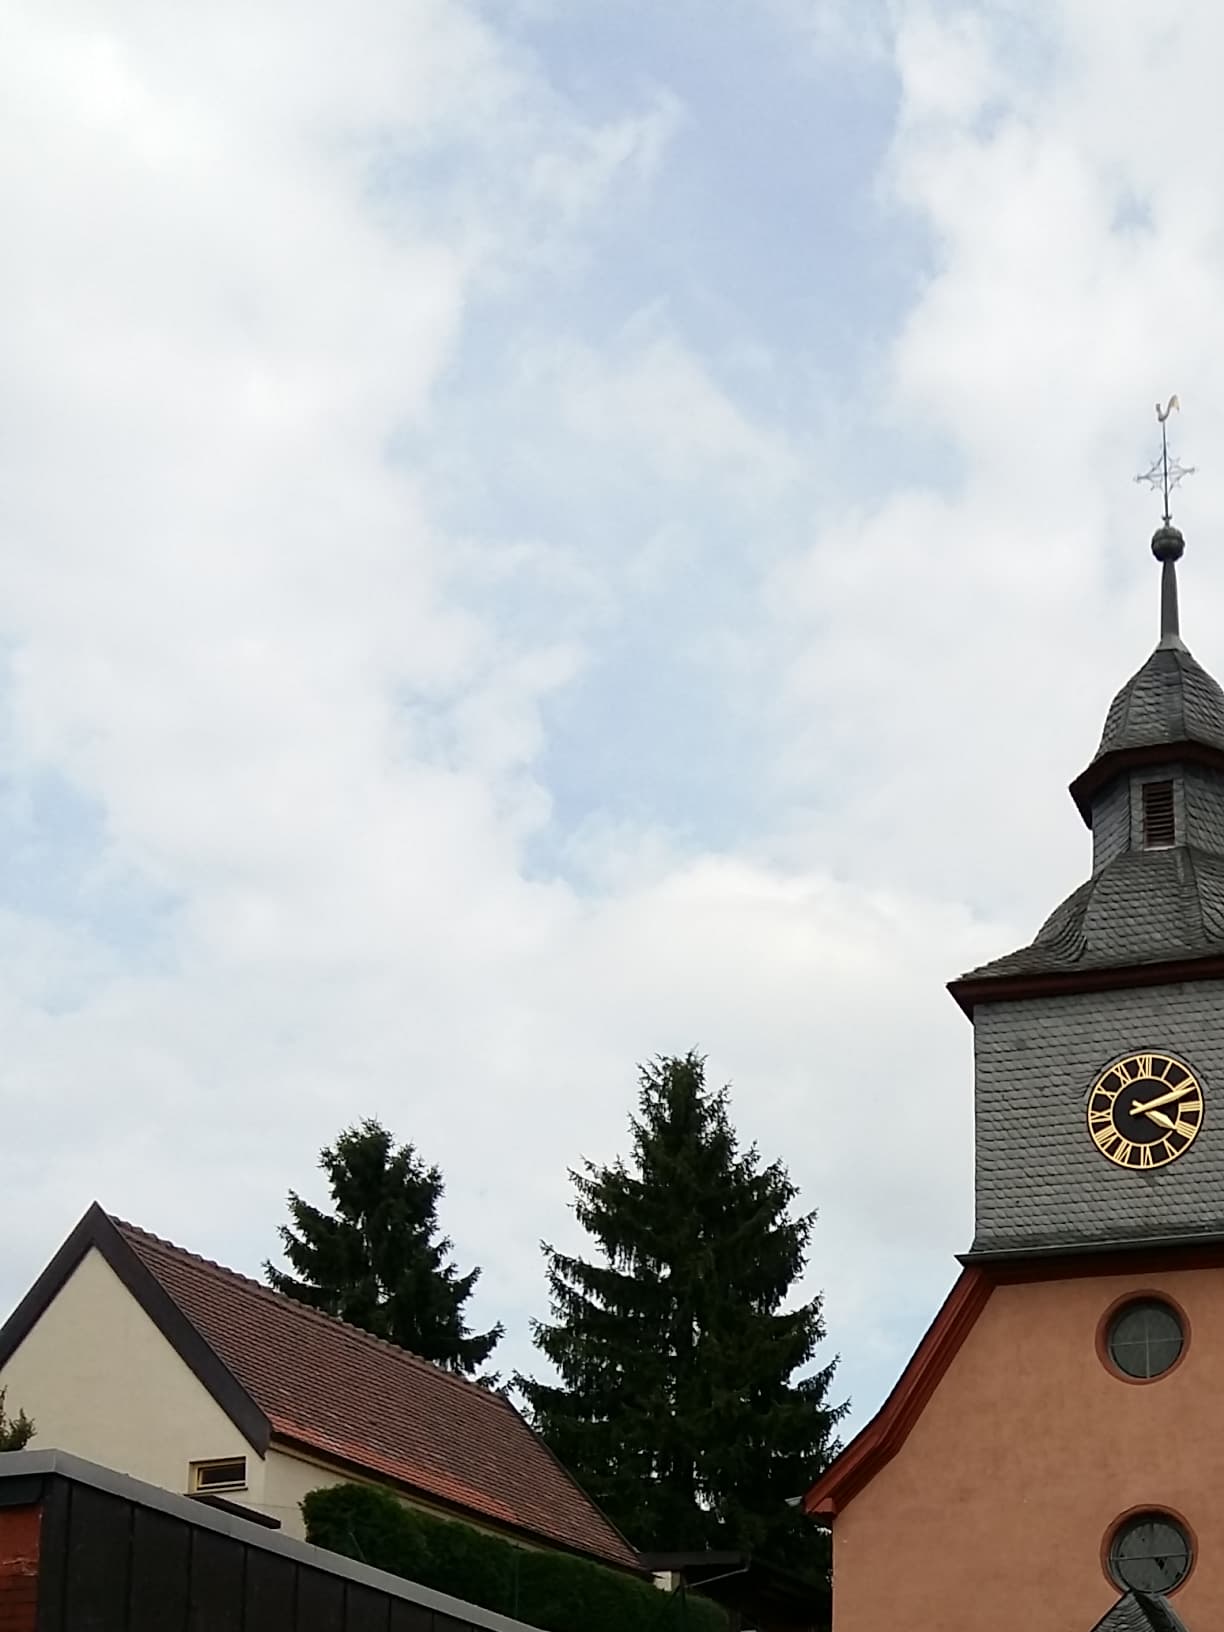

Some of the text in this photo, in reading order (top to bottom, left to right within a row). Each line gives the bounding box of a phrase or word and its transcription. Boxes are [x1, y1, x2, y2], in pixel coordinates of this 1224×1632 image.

[1111, 1063, 1131, 1087] XI
[1136, 1055, 1152, 1079] XII
[1095, 1084, 1117, 1101] X
[1089, 1108, 1112, 1123] IX
[1140, 1143, 1154, 1168] VI
[1163, 1139, 1180, 1159] V
